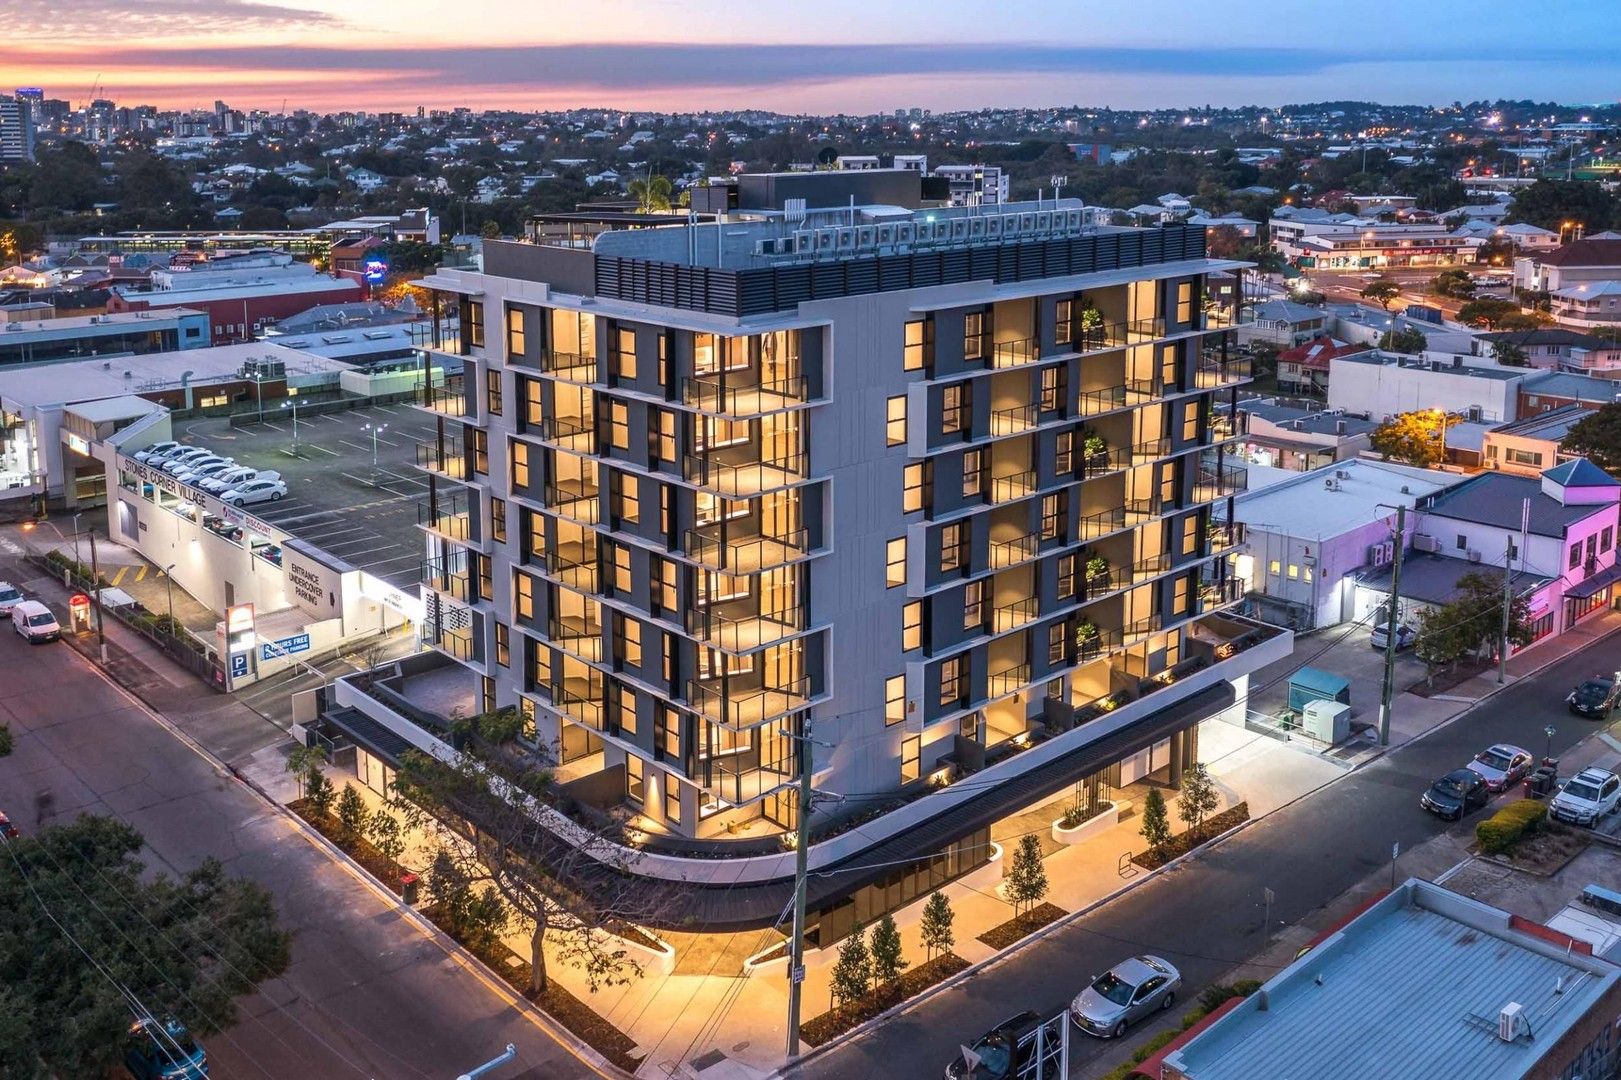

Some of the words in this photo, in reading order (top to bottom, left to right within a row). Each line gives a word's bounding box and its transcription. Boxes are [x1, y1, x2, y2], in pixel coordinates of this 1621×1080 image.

[124, 459, 148, 480] STONES
[150, 471, 176, 494] CORNER
[178, 484, 207, 508] VILLAGE
[245, 517, 272, 535] DISCOUNT
[291, 563, 320, 585] ENTRANCE
[288, 572, 323, 598] UNDERCOVER
[295, 586, 318, 606] PARKING
[293, 635, 308, 645] FREE
[235, 657, 244, 669] P
